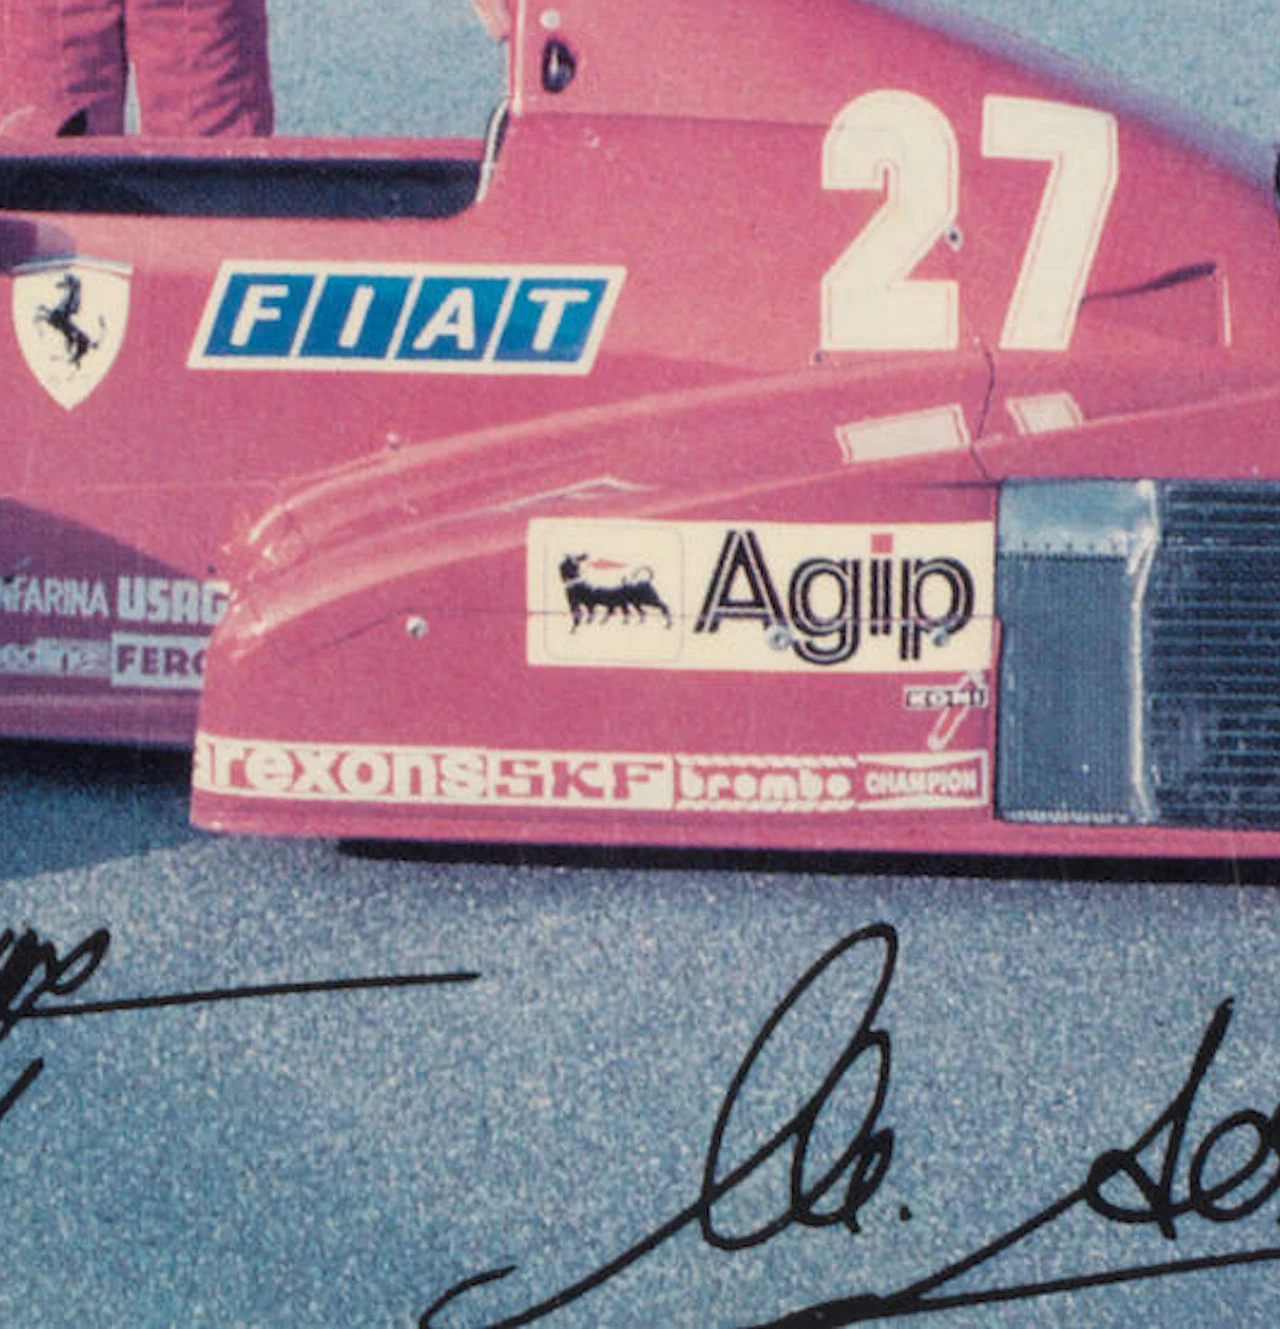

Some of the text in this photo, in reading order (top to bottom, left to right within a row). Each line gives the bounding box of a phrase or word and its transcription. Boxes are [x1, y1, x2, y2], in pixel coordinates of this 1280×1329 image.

[821, 89, 1119, 351] 27
[228, 283, 592, 352] FIAT
[694, 529, 975, 665] Agip
[494, 758, 665, 801] SKF
[864, 766, 978, 794] CHAMPION
